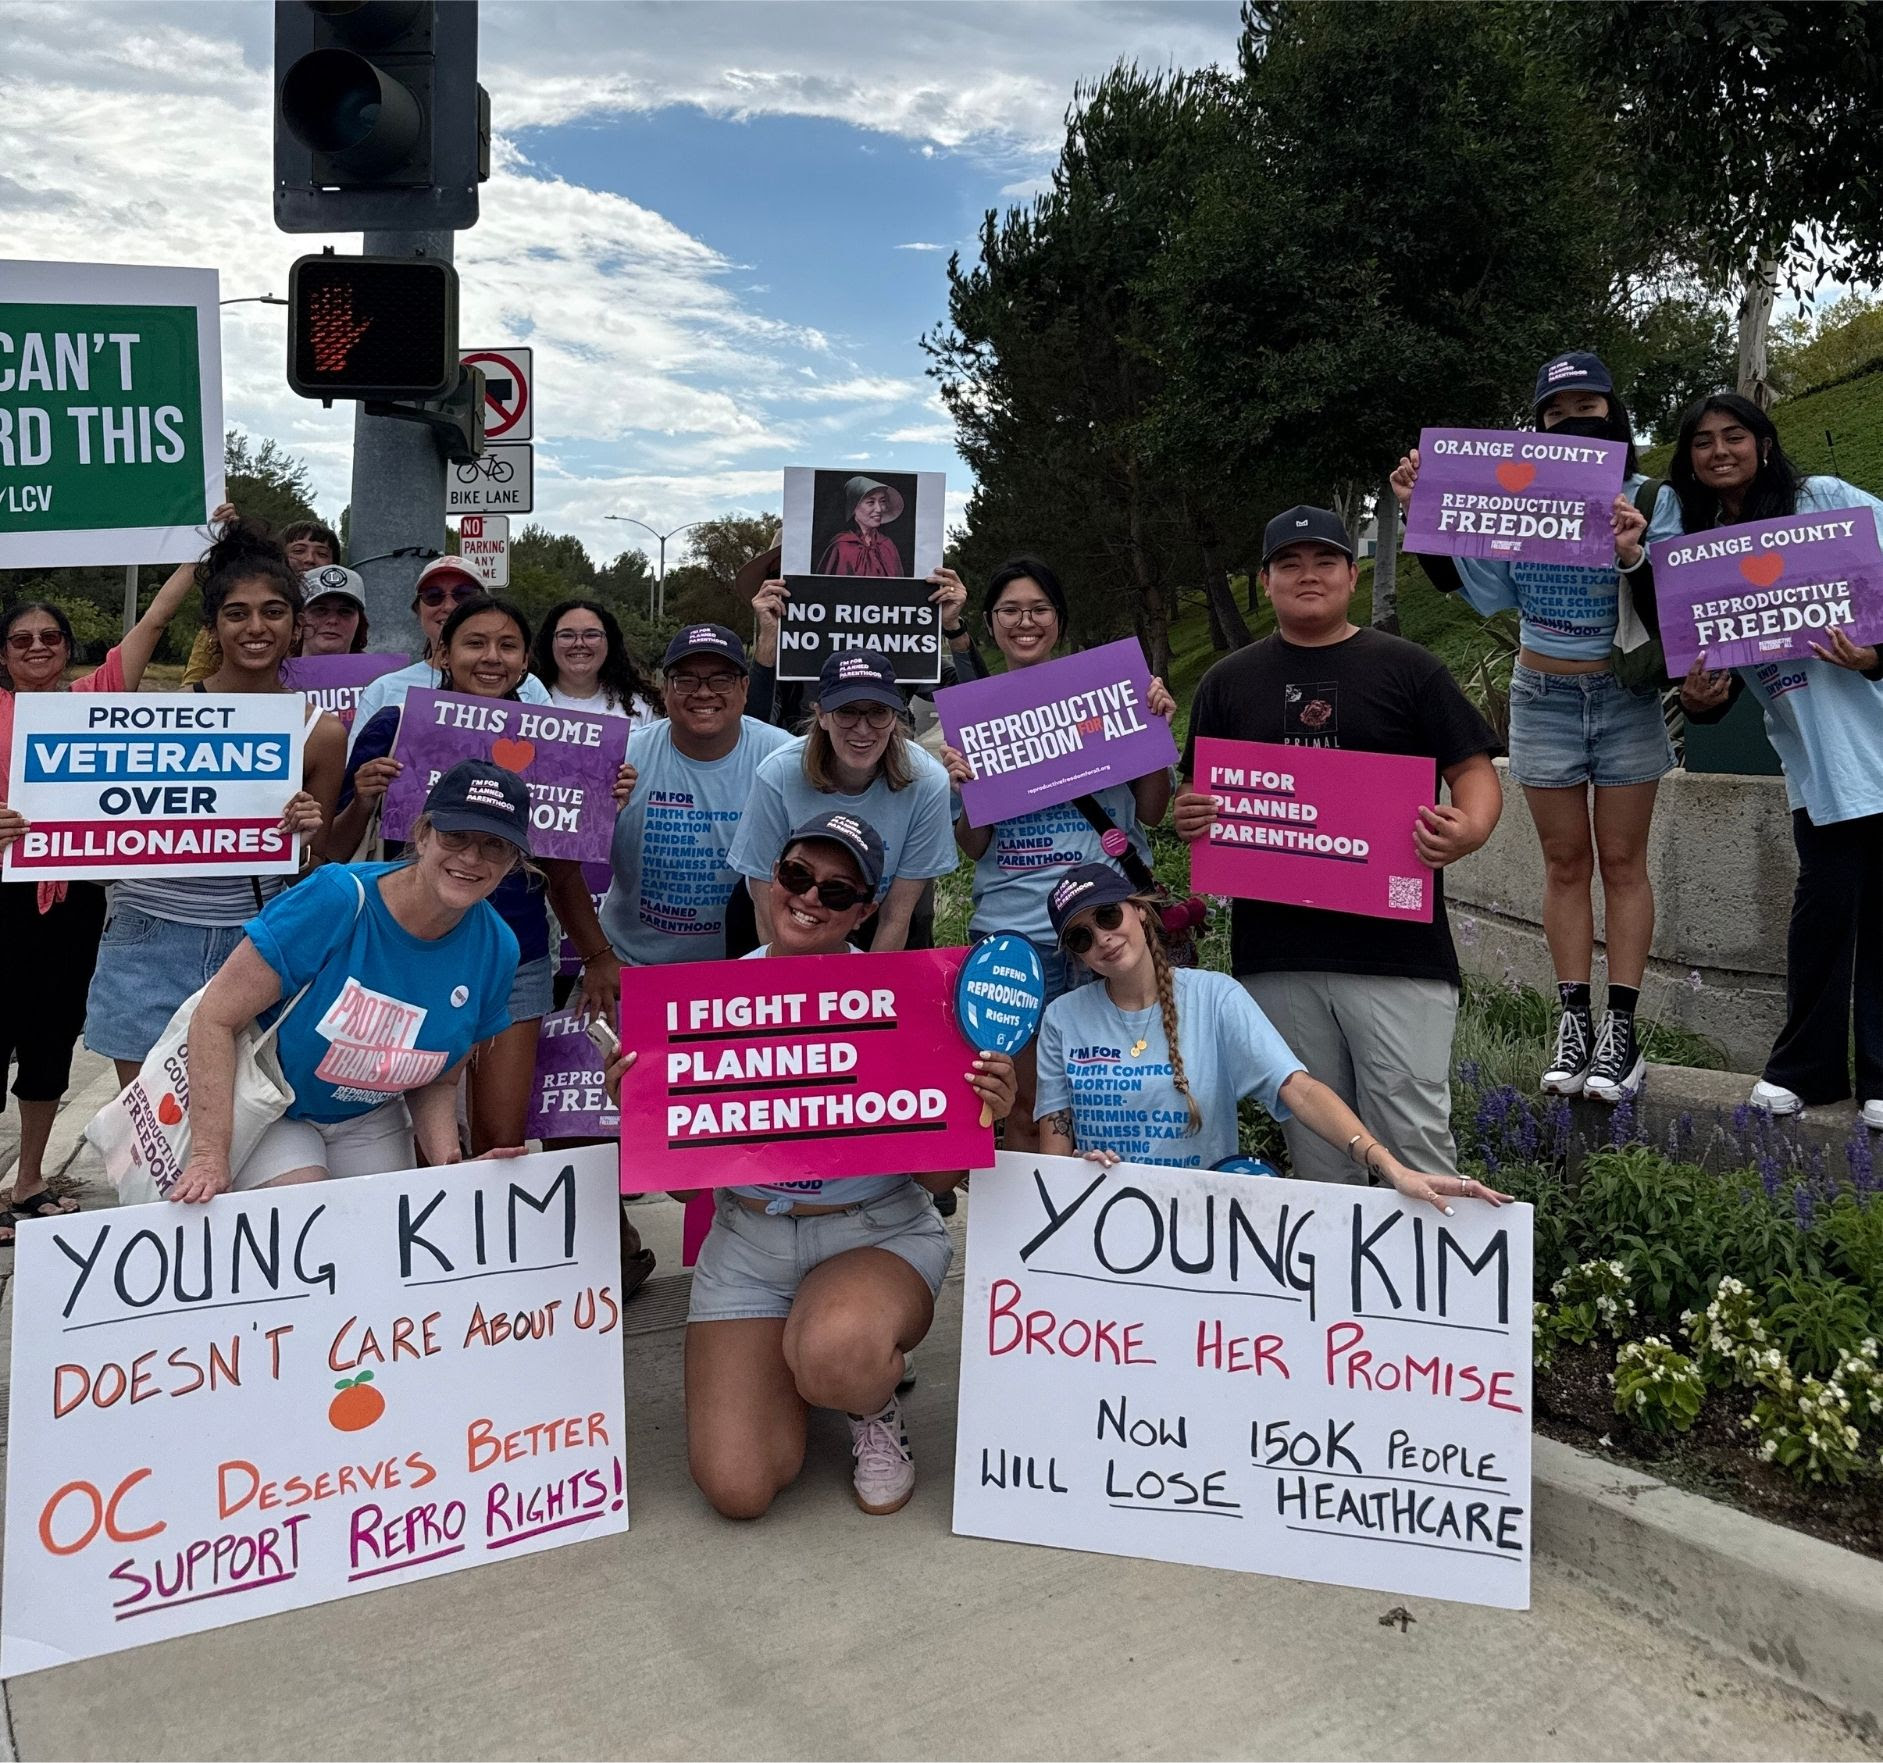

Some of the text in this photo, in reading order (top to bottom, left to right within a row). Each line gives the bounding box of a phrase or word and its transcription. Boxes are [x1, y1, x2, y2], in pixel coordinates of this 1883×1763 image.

[67, 405, 186, 465] THIS
[1433, 440, 1608, 465] ORANGE COUNTY
[450, 490, 519, 504] BIKE LANE
[1441, 493, 1586, 516] REPRODUCTIVE
[463, 519, 481, 535] NO
[1438, 510, 1583, 541] FREEDOM
[464, 540, 505, 554] PARKING
[1667, 520, 1855, 567] ORANGE COUNTY
[474, 556, 496, 567] ANY
[330, 572, 340, 582] L
[482, 568, 497, 579] ME
[1514, 572, 1578, 584] WELLNESS
[1534, 584, 1588, 596] TESTING
[1691, 581, 1850, 620] REPRODUCTIVE
[787, 603, 933, 625] NO RIGHTS
[1695, 599, 1855, 646] FREEDOM
[781, 631, 938, 653] NO THANKS
[88, 706, 236, 729] PROTECT
[434, 700, 604, 748] THIS HOME
[959, 679, 1139, 754] REPRODUCTIVE
[966, 707, 1147, 781] FREEDOM FOR ALL
[34, 741, 282, 774] VETERANS
[471, 779, 499, 788] I'M FOR
[1210, 766, 1295, 791] I'M FOR
[98, 786, 218, 815] OVER
[466, 794, 515, 812] PARENTHOOD
[468, 787, 504, 798] PLANNED
[648, 790, 694, 804] I'M FOR
[646, 807, 684, 820] BIRTH
[1210, 795, 1318, 822] PLANNED
[644, 820, 712, 833] ABORTION
[23, 827, 284, 858] BILLIONAIRES
[642, 844, 714, 857] AFFIRMING
[643, 832, 699, 846] GENDER-
[1210, 822, 1369, 856] PARENTHOOD
[642, 856, 707, 870] WELLNESS
[997, 851, 1083, 866] PARENTHOOD
[641, 867, 716, 882] STI TESTING
[641, 879, 692, 894] CANCER
[640, 896, 697, 918] PLANNED
[667, 894, 730, 906] EDUCATIO
[639, 911, 722, 932] PARENTHOOD
[992, 965, 1027, 983] DEFEND
[967, 980, 1039, 1010] REPRODUCTIVE
[328, 984, 419, 1048] PROTECT
[667, 988, 898, 1031] I FIGHT FOR
[985, 1008, 1021, 1027] RIGHTS
[323, 1043, 445, 1085] TRANS YOUTH
[667, 1042, 859, 1084] PLANNED
[1069, 1046, 1121, 1059] I'M FOR
[542, 1070, 606, 1089] REPRO
[1066, 1063, 1175, 1077] BIRTH CONTRO
[667, 1088, 948, 1138] PARENTHOOD
[131, 1081, 183, 1182] REPRODUCTIVE
[122, 1091, 174, 1197] FREEDOM
[1090, 1140, 1151, 1153] TESTING
[52, 1165, 576, 1318] YOUNG KIM
[1019, 1168, 1509, 1325] YOUNG KIM
[53, 1287, 620, 1419] DOESN'T CARE ABOUT US
[988, 1278, 1525, 1414] BROKE HER PROMISE
[1097, 1395, 1508, 1483] NOW 150K PEOPLE
[38, 1412, 611, 1556] OC DESERVES BETTER
[981, 1448, 1525, 1551] WILL LOSE HEALTHCARE
[108, 1456, 626, 1608] SUPPORT REPRO RIGHTS!
